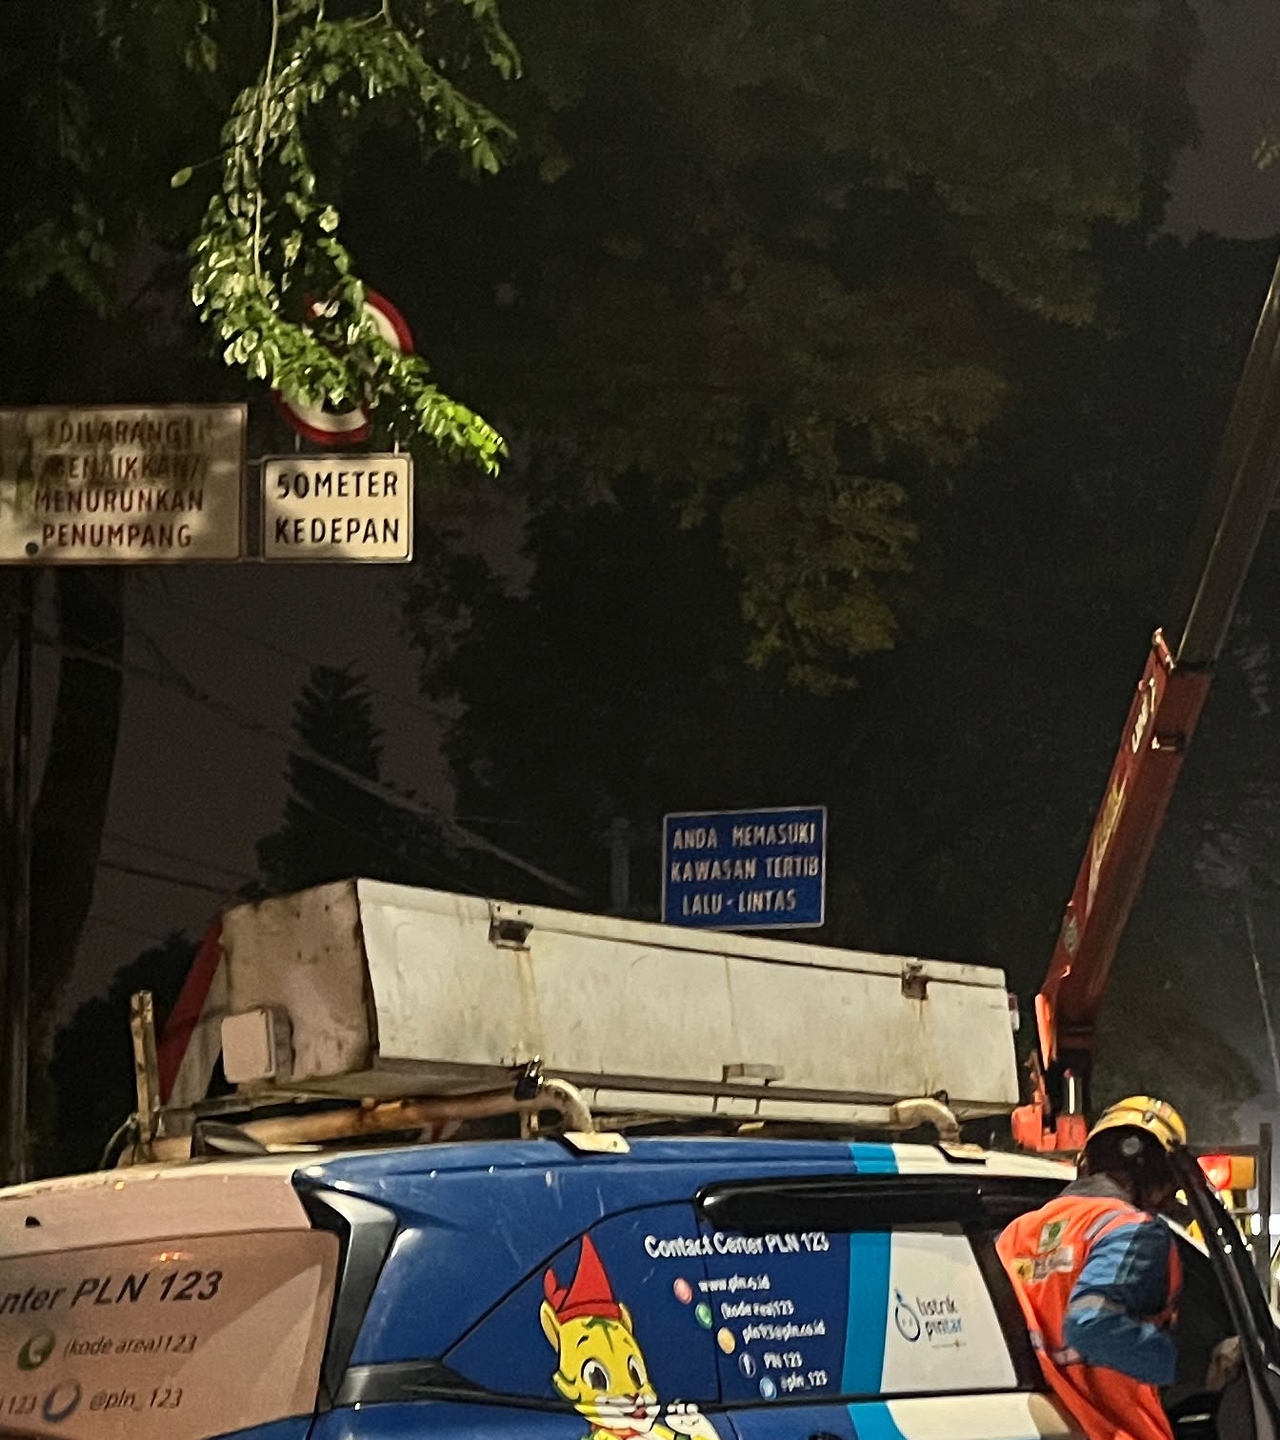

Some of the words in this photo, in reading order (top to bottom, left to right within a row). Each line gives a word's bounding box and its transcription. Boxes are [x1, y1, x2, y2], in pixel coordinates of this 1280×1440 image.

[33, 488, 204, 512] MENURUNKAN
[41, 523, 193, 549] PENUMPANG
[275, 515, 400, 544] KEDEPAN
[673, 827, 718, 850] ANDA
[731, 822, 816, 848] MEMASUKI
[670, 857, 757, 883] KAWASAN
[766, 854, 820, 879] TERTIB
[643, 1234, 713, 1259] Contact
[765, 1232, 801, 1254] PLN
[801, 1231, 830, 1252] 123
[70, 1272, 151, 1308] PLN
[158, 1269, 224, 1302] 123
[8, 1394, 38, 1416] 123
